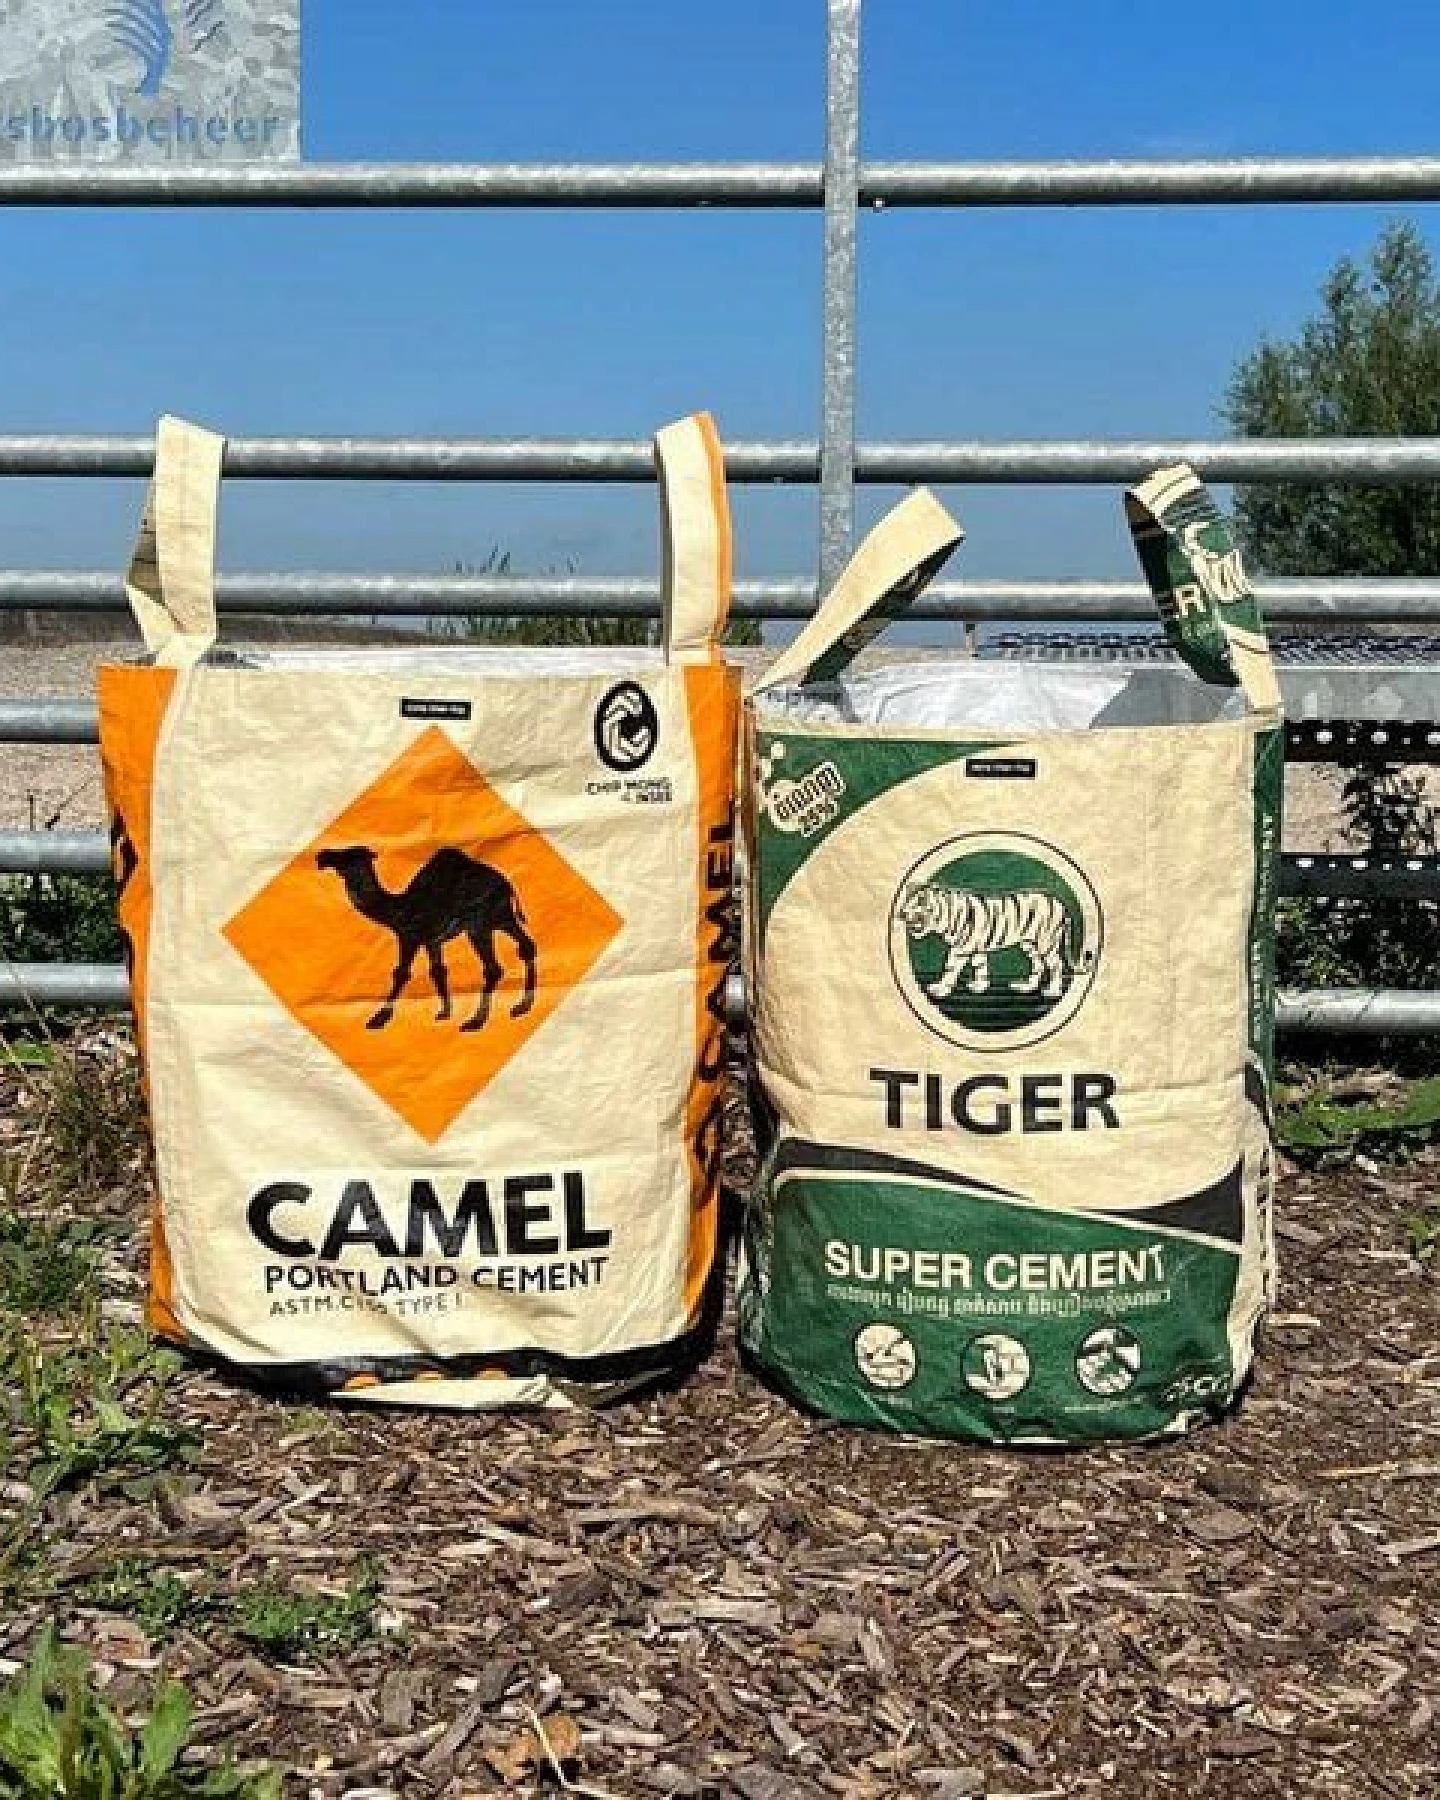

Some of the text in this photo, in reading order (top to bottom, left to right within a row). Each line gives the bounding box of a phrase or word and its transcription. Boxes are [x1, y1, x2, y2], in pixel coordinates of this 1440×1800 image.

[0, 104, 280, 144] sbosbeheer
[869, 1068, 1121, 1134] TIGER
[246, 1170, 613, 1260] CAMEL
[264, 1256, 610, 1297] PORTLAND CEMENT
[824, 1239, 1166, 1291] SUPER CEMENT
[396, 1292, 448, 1317] TYPE
